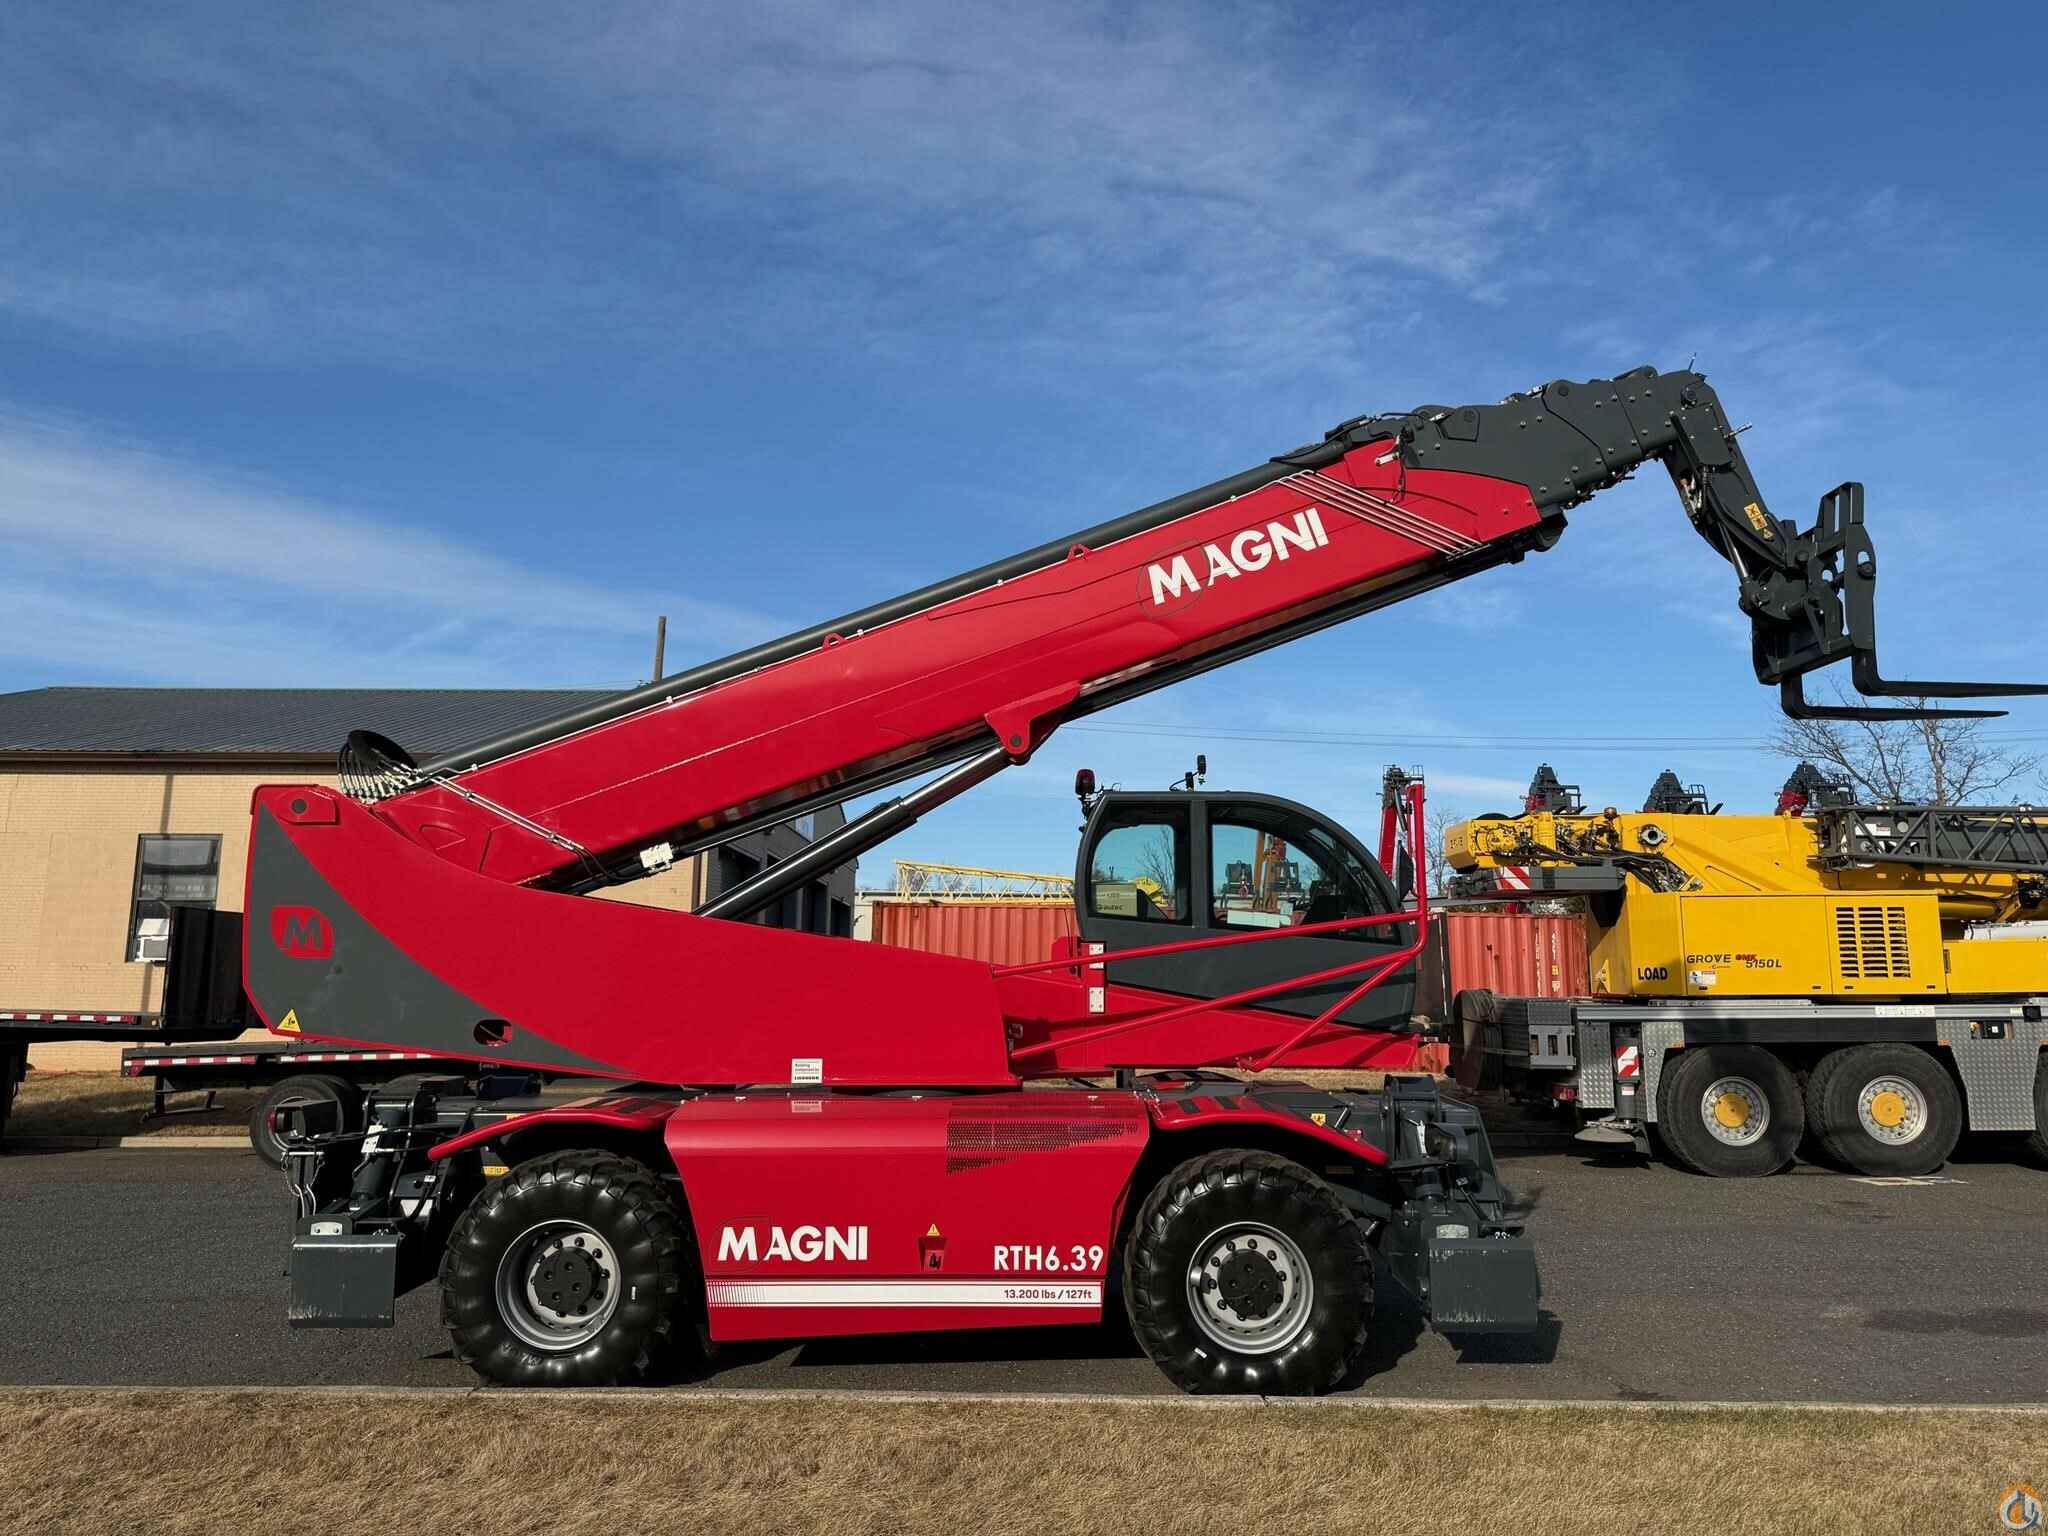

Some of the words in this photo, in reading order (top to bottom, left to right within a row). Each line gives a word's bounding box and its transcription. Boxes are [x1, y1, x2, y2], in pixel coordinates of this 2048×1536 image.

[1148, 507, 1329, 604] MAGNI
[1687, 954, 1731, 964] GROVE
[1746, 959, 1782, 968] 5150L
[1638, 967, 1668, 981] LOAD
[718, 1225, 868, 1262] MAGNI
[994, 1245, 1104, 1271] RTH6.39
[1004, 1289, 1039, 1299] 13.200
[1041, 1289, 1056, 1299] lbs
[1057, 1289, 1064, 1299] /
[1065, 1289, 1092, 1299] 127ft
